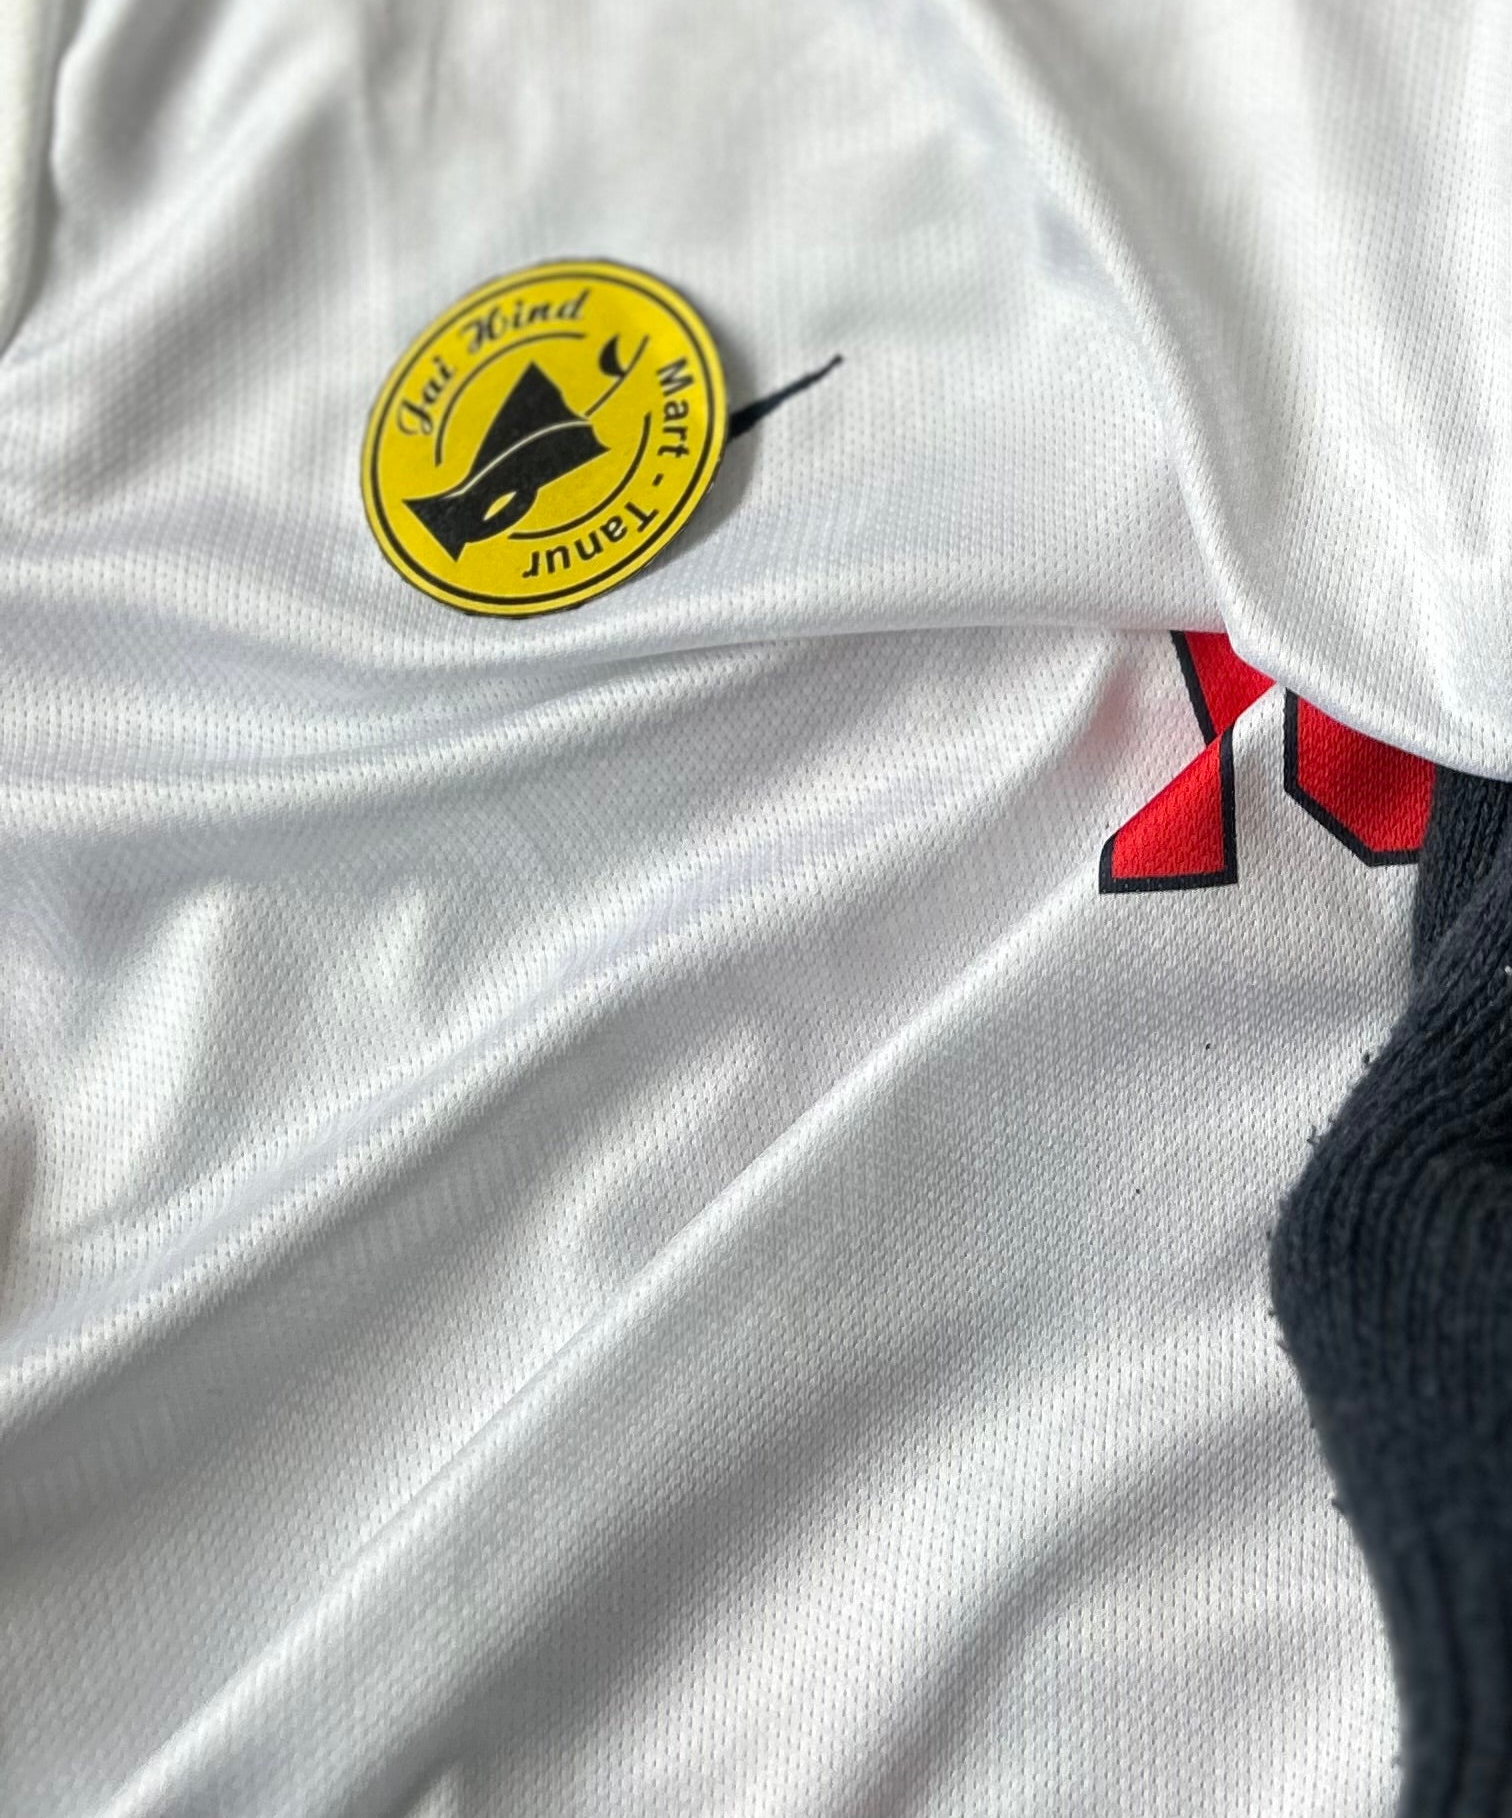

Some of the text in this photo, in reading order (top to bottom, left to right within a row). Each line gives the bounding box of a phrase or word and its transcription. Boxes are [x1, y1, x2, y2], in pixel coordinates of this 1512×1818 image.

[397, 288, 591, 435] Jai Hind
[656, 357, 694, 459] Mart
[523, 502, 659, 578] Tanur
